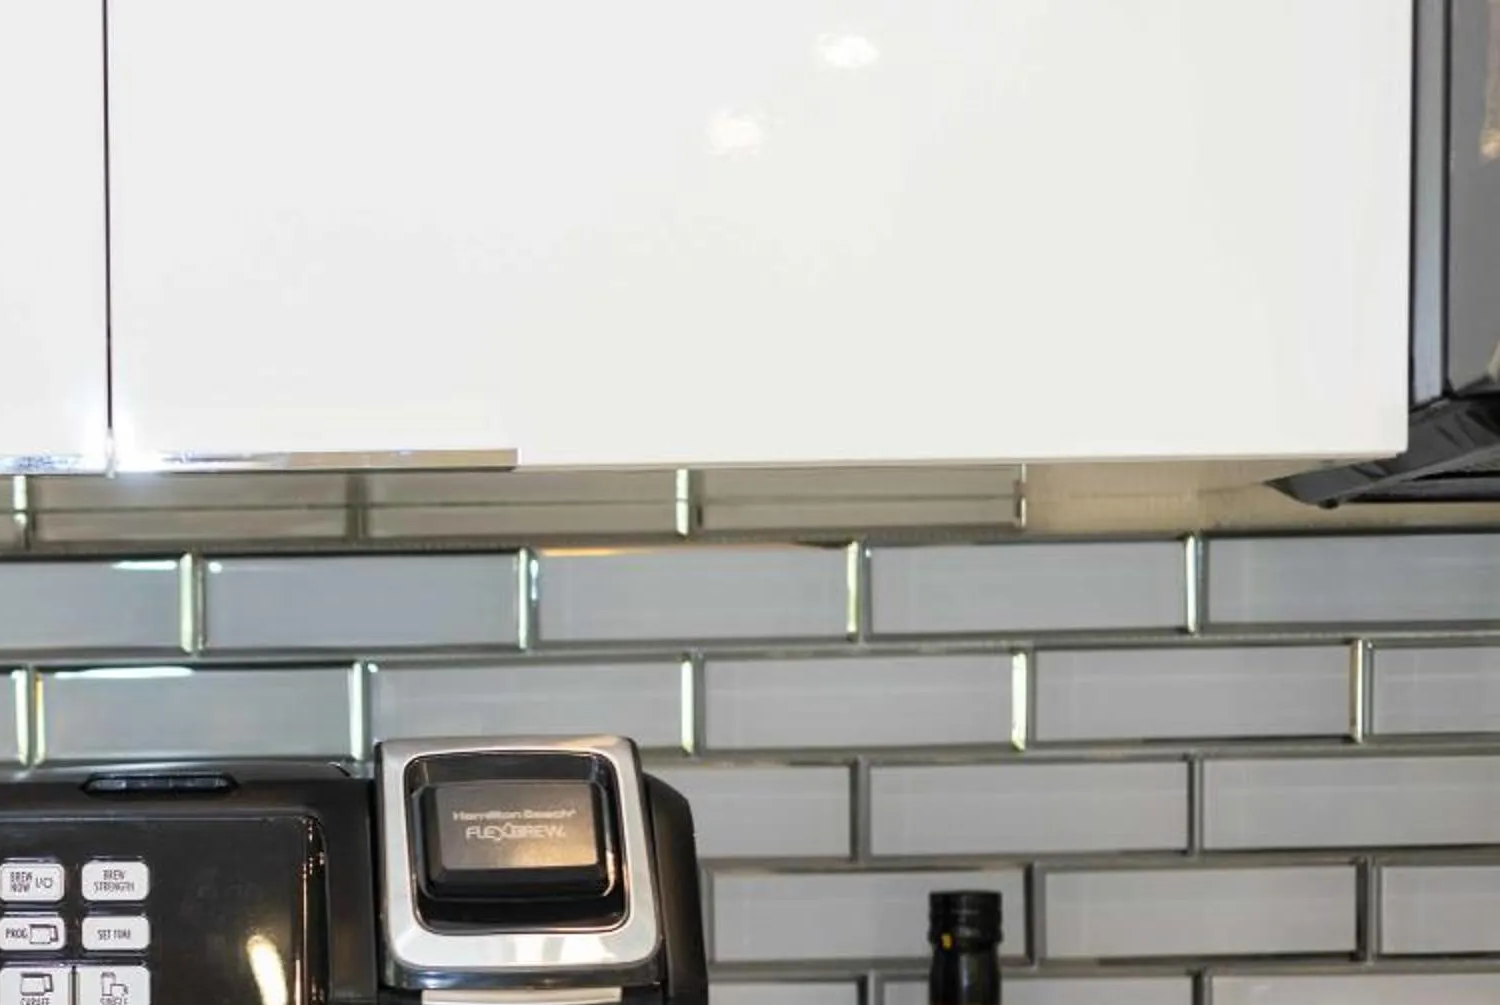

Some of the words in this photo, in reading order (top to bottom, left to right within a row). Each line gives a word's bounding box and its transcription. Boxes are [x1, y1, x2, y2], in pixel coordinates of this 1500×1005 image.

[452, 810, 521, 821] Hamilton
[10, 871, 33, 882] BREW
[103, 869, 126, 881] BREW
[93, 881, 136, 892] STRENGTH
[97, 928, 111, 940] SET
